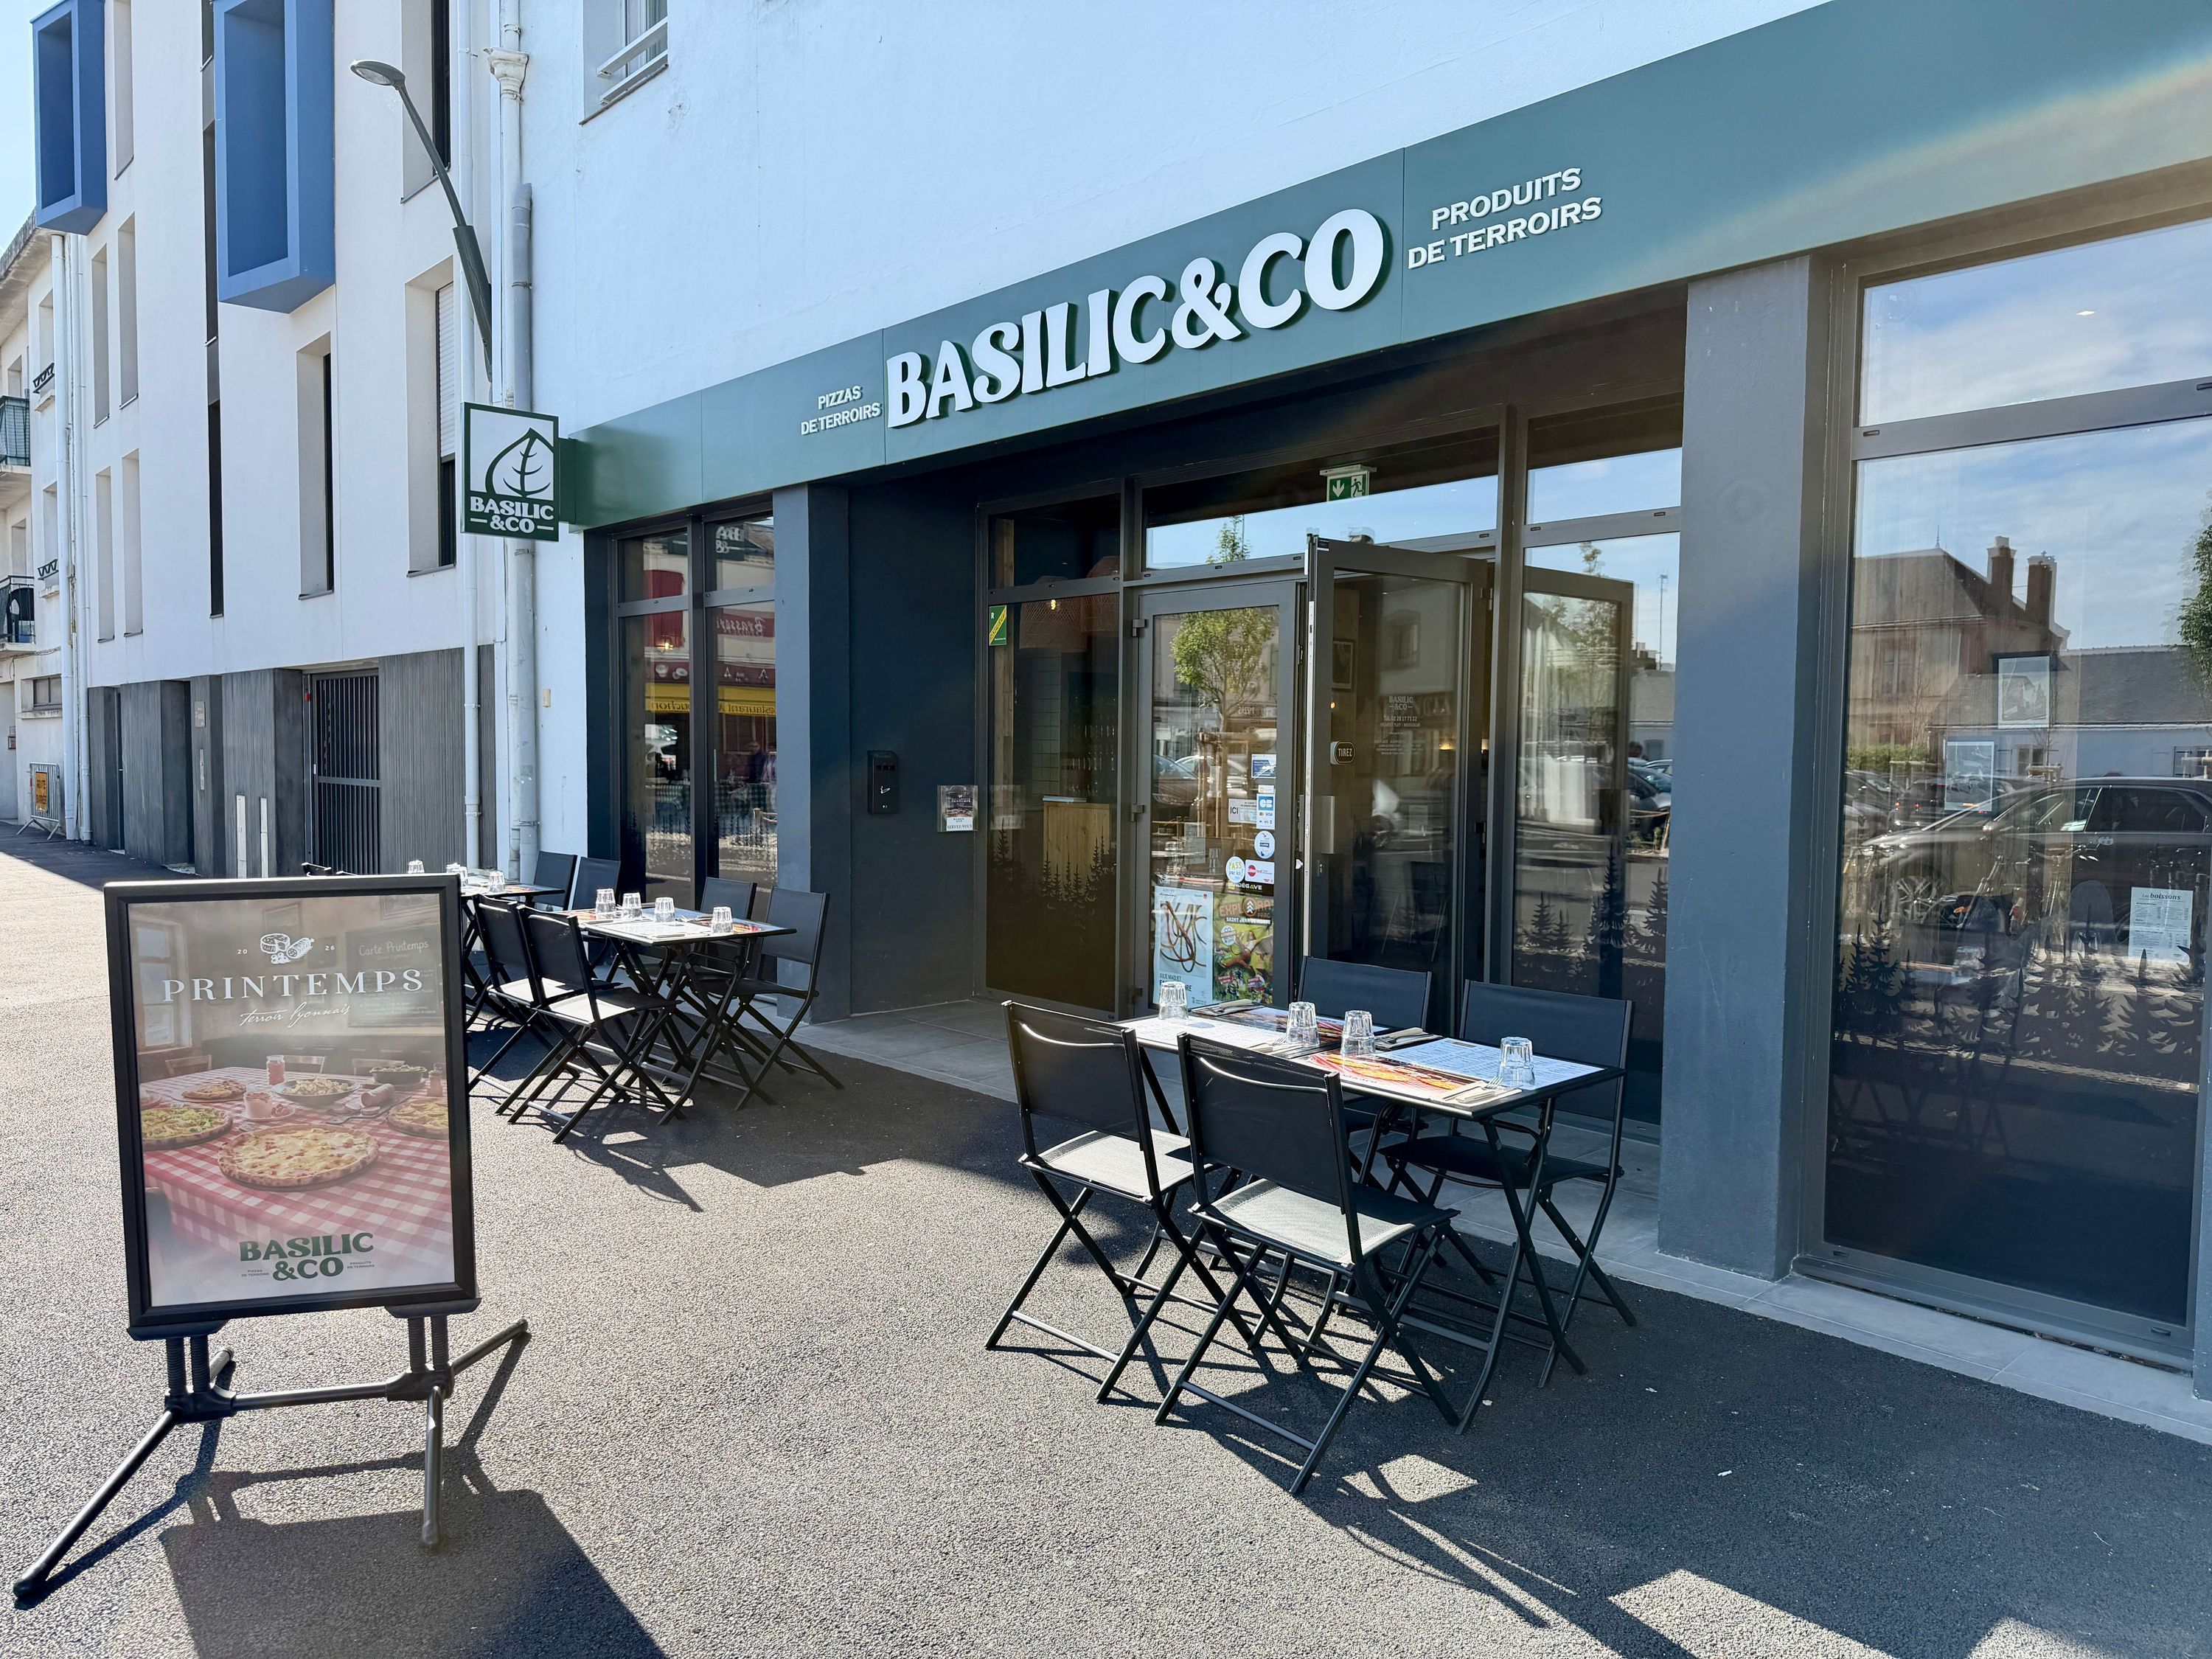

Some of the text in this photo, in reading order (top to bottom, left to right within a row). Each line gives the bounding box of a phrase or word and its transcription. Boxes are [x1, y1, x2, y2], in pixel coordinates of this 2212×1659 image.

[1432, 167, 1582, 231] PRODUITS
[1408, 197, 1602, 269] DE TERROIRS
[886, 208, 1384, 428] BASILIC&CO
[818, 386, 862, 410] PIZZAS
[801, 402, 882, 436] DE TERROIRS
[470, 496, 554, 520] BASILIC
[490, 515, 535, 533] &CO
[1338, 748, 1353, 757] TIREZ
[1229, 862, 1242, 870] PASS
[358, 940, 429, 956] Carte Printemps
[161, 969, 423, 1002] PRINTEMPS
[239, 1001, 351, 1028] terroir lyonnais
[239, 1232, 374, 1262] BASILIC
[272, 1256, 344, 1281] &CO
